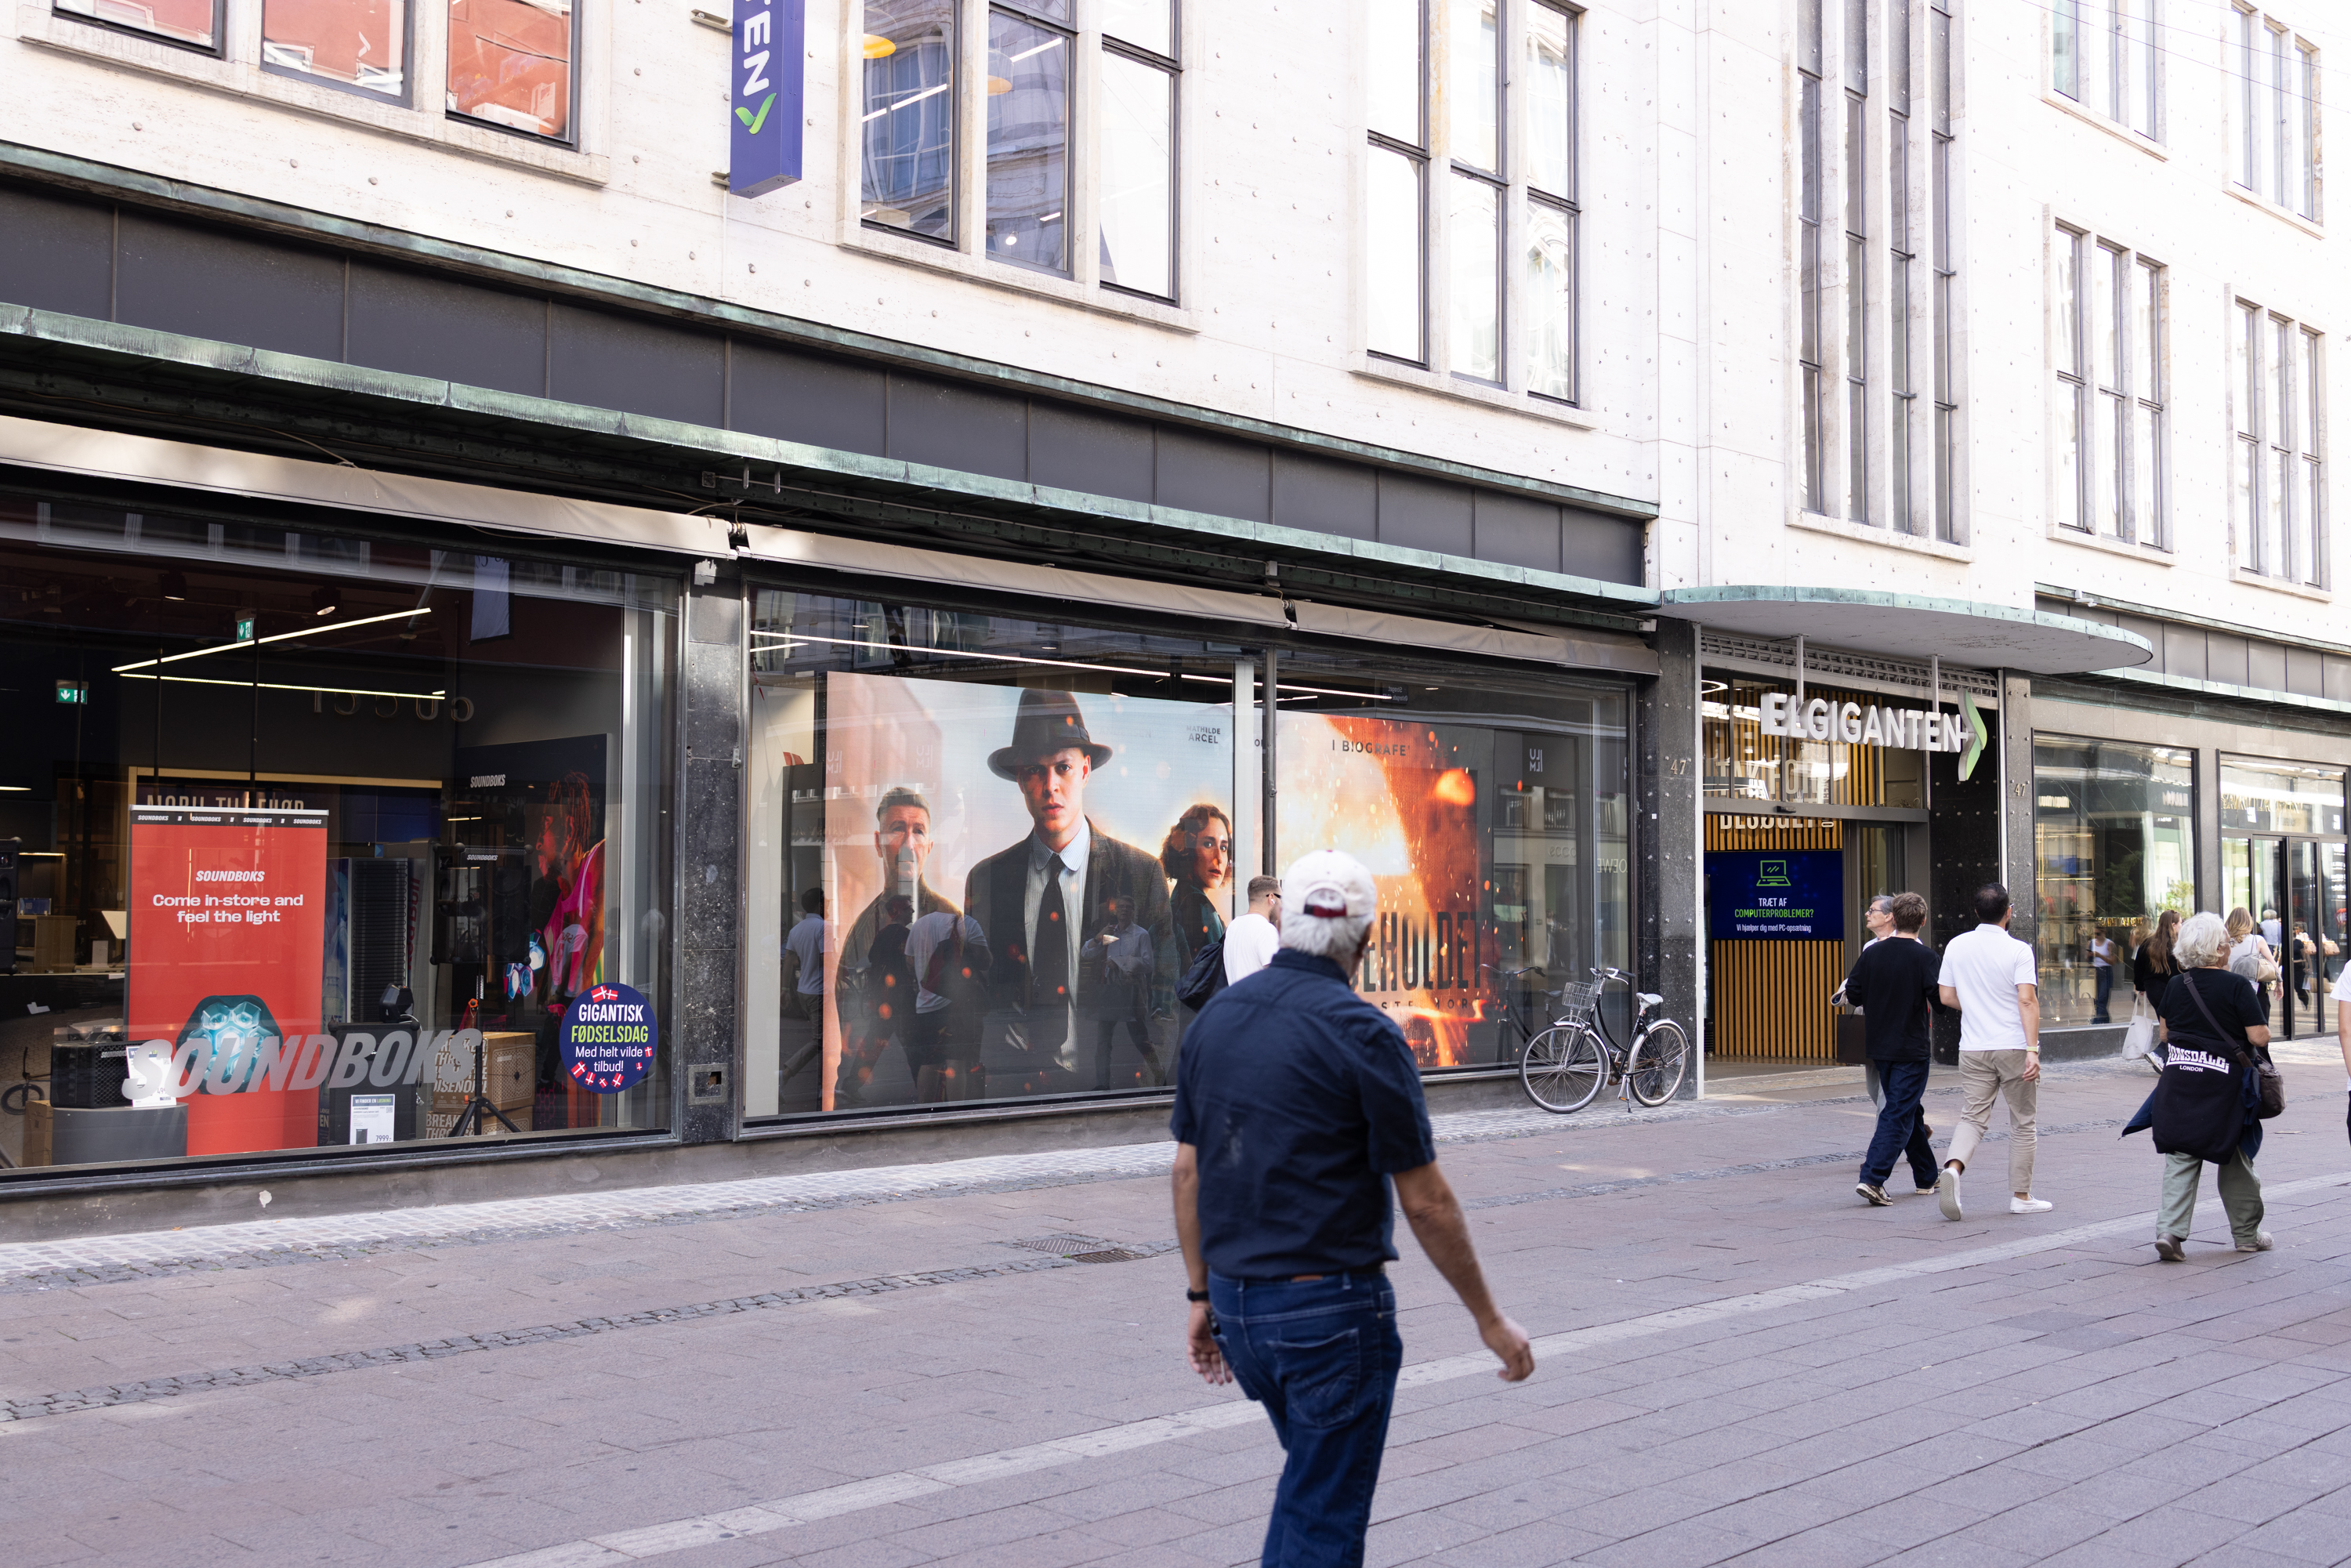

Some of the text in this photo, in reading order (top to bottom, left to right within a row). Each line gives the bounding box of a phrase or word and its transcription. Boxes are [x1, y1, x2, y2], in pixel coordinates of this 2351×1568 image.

[743, 0, 771, 97] EN
[1761, 693, 1961, 753] ELGIGANTEN
[1188, 733, 1219, 744] ARCEL
[1342, 740, 1410, 756] BIOGRAFE
[1670, 759, 1686, 776] 47
[470, 773, 506, 788] SOUNDBOKS
[2014, 783, 2026, 797] 47
[196, 870, 265, 882] SOUNDBOKS
[153, 893, 304, 907] Come in-store and
[1759, 897, 1788, 907] TRÆT AF
[177, 909, 281, 925] feel the light
[1734, 908, 1814, 918] COMPUTERPROBLEMER?
[1737, 923, 1742, 932] Vi
[1742, 923, 1759, 933] hjælper
[1767, 923, 1779, 932] med
[578, 1004, 644, 1023] GIGANTISK
[571, 1025, 649, 1043] FØDSELSDAG
[575, 1045, 643, 1058] Med helt vilde
[121, 1028, 483, 1099] SOUNDBOKS
[594, 1060, 624, 1072] tilbud!
